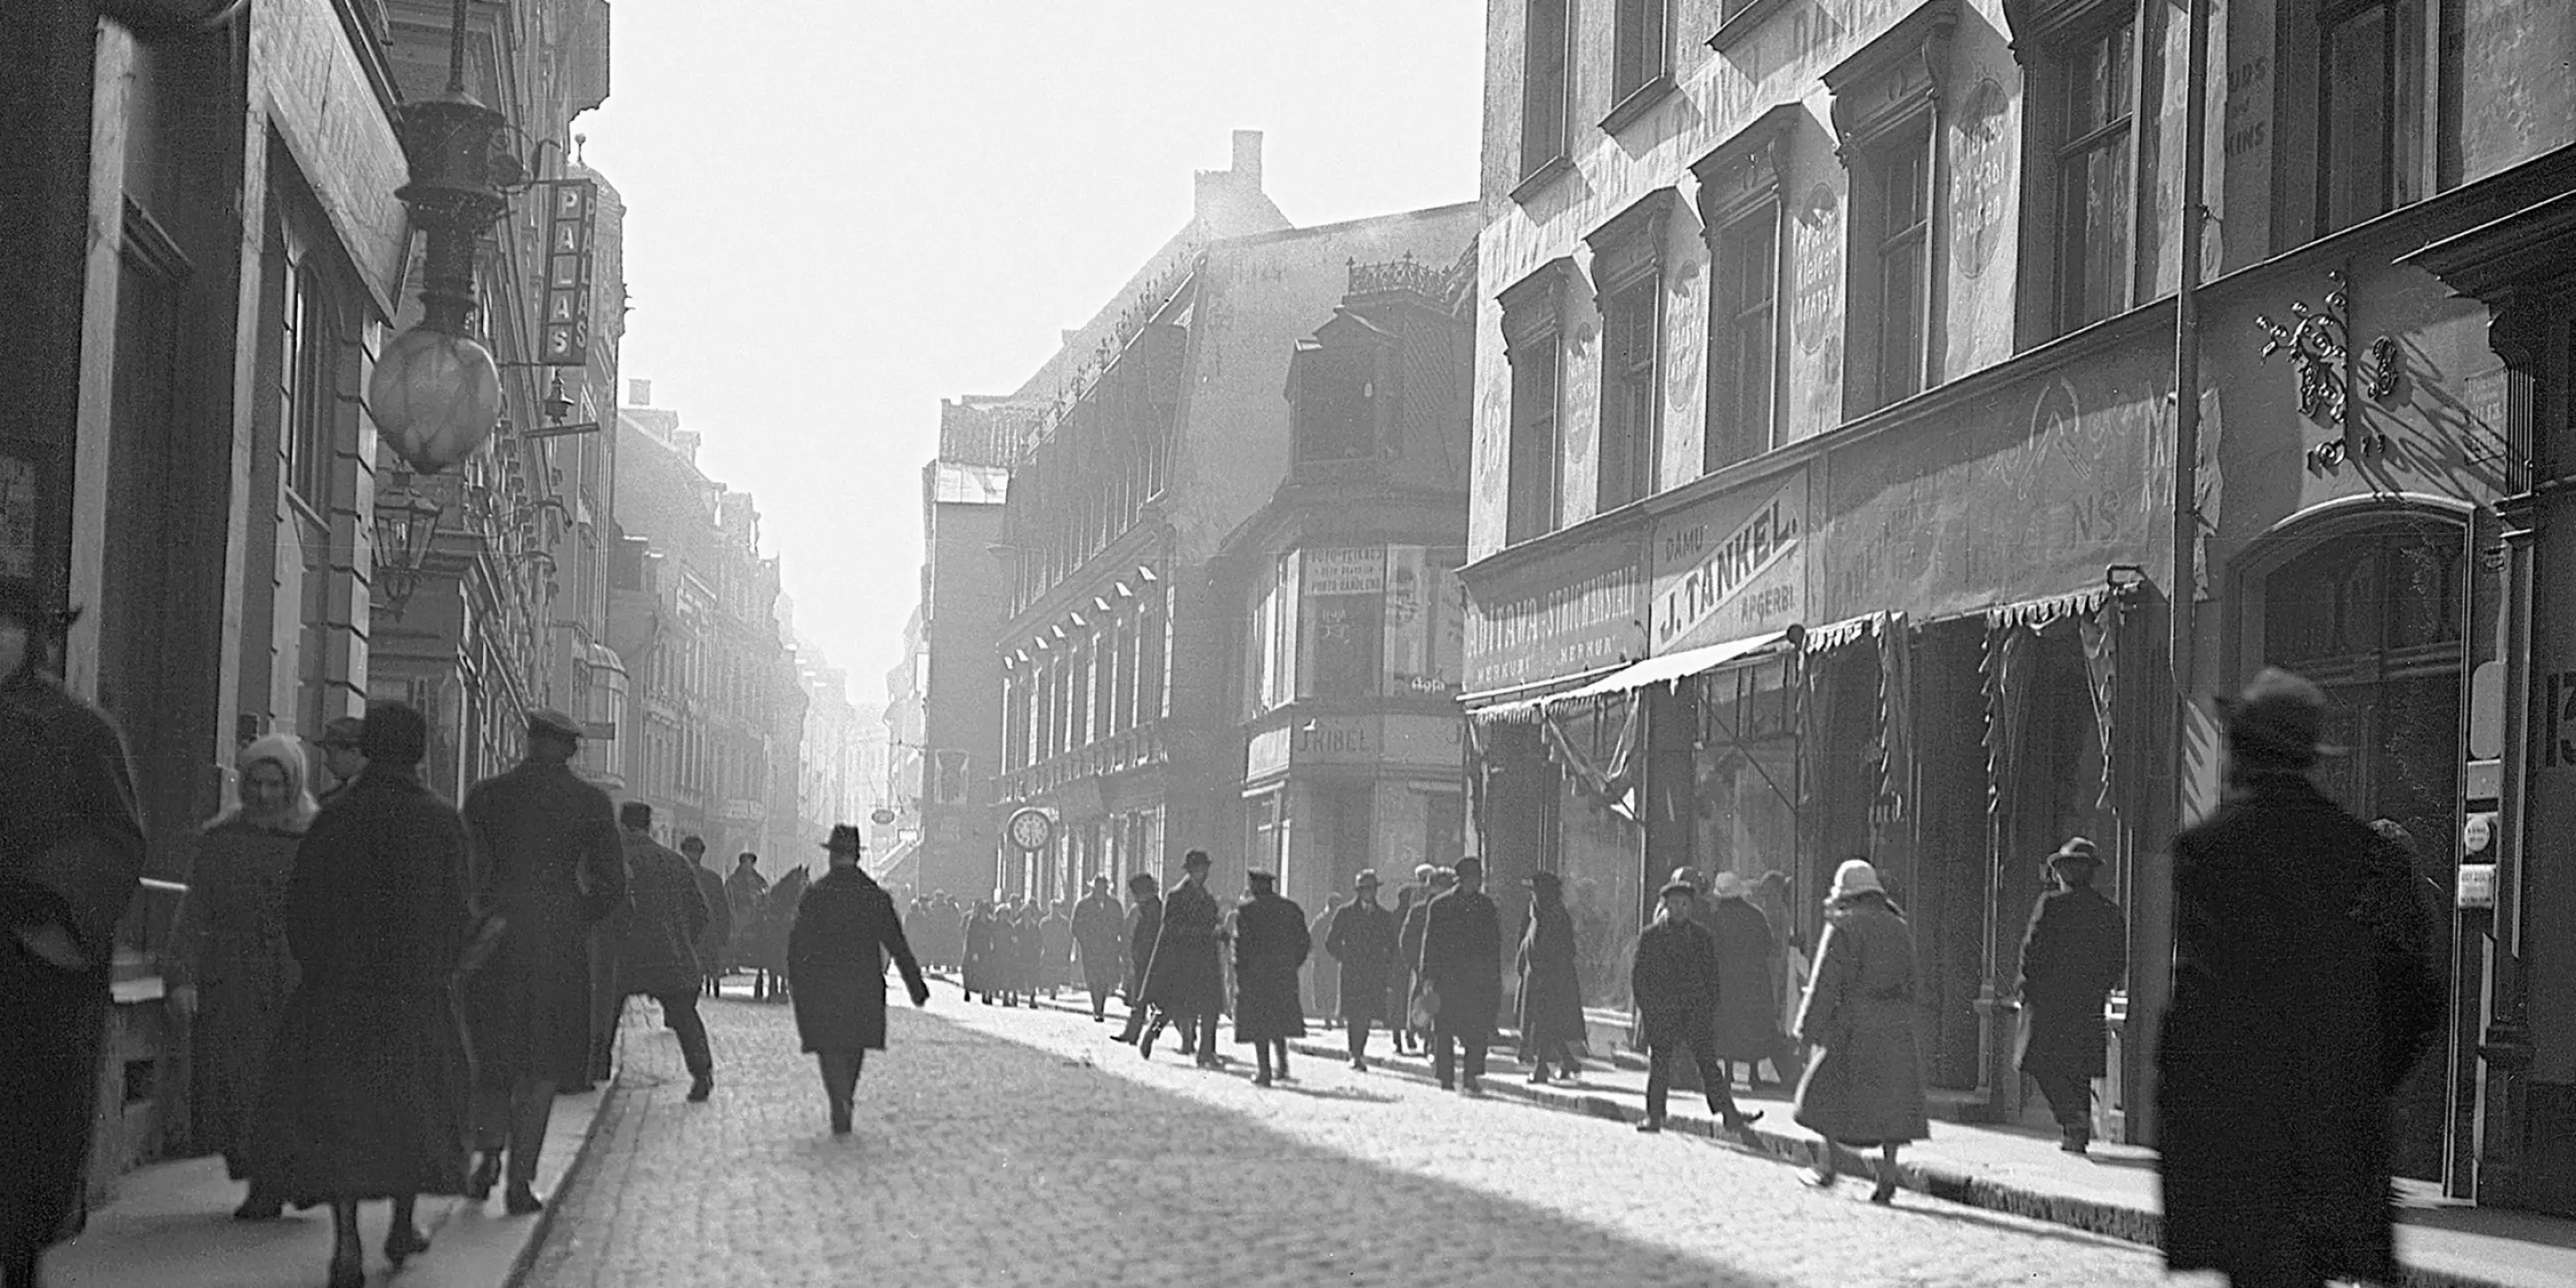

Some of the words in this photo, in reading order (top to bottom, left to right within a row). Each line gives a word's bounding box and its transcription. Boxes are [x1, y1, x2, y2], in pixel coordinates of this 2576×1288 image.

[553, 191, 579, 353] PALAS
[575, 196, 595, 349] PALAS
[1411, 676, 1445, 694] Agfa
